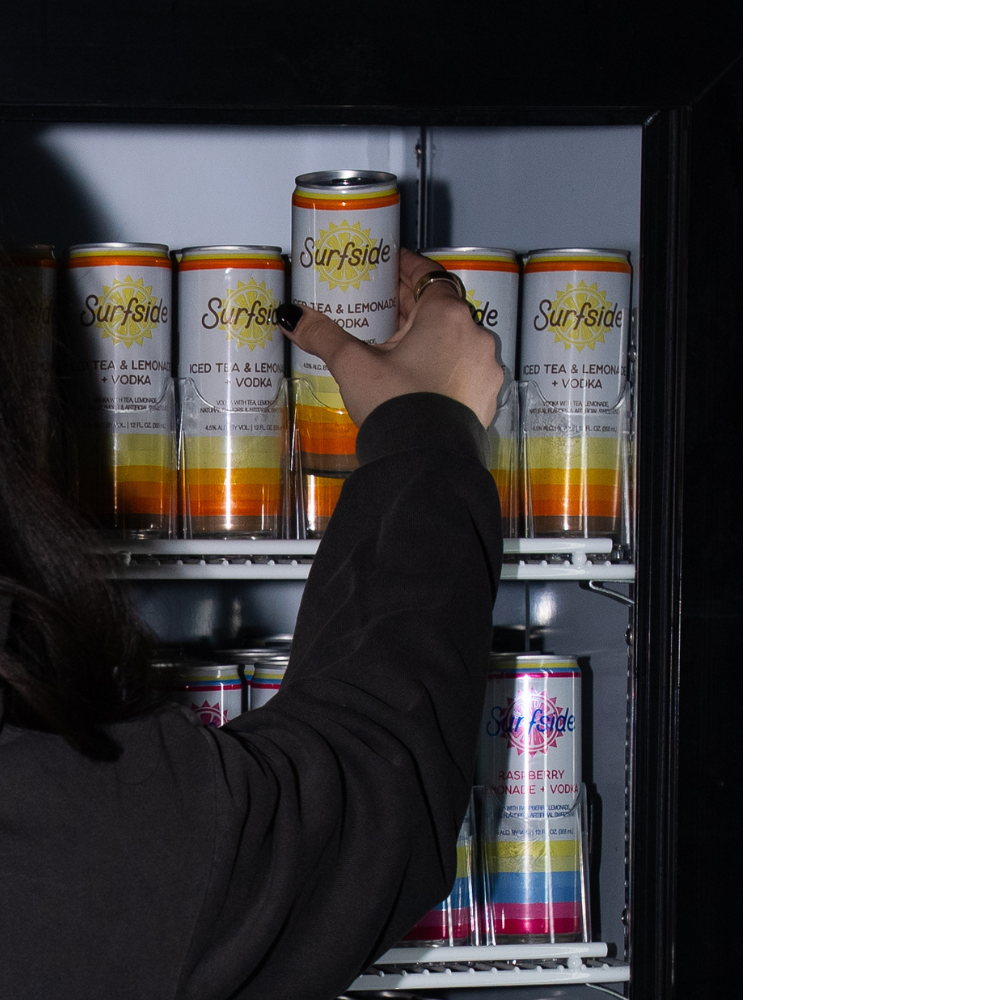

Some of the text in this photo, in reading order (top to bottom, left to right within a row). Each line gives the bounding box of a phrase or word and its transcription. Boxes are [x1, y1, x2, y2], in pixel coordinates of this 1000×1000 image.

[300, 236, 391, 271] Surfside
[81, 294, 169, 327] Surfside
[336, 303, 344, 314] &
[347, 297, 397, 314] LEMONADE
[533, 299, 624, 331] Surfside
[119, 360, 128, 370] &
[189, 363, 212, 374] ICED
[215, 362, 240, 373] TEA
[243, 362, 252, 373] &
[523, 365, 541, 375] ICED
[543, 364, 567, 374] TEA
[570, 364, 579, 374] &
[101, 375, 152, 385] + VODKA
[235, 377, 273, 388] VODKA
[551, 378, 603, 389] + VODKA
[486, 706, 576, 737] Surfside
[550, 783, 579, 795] VODKA
